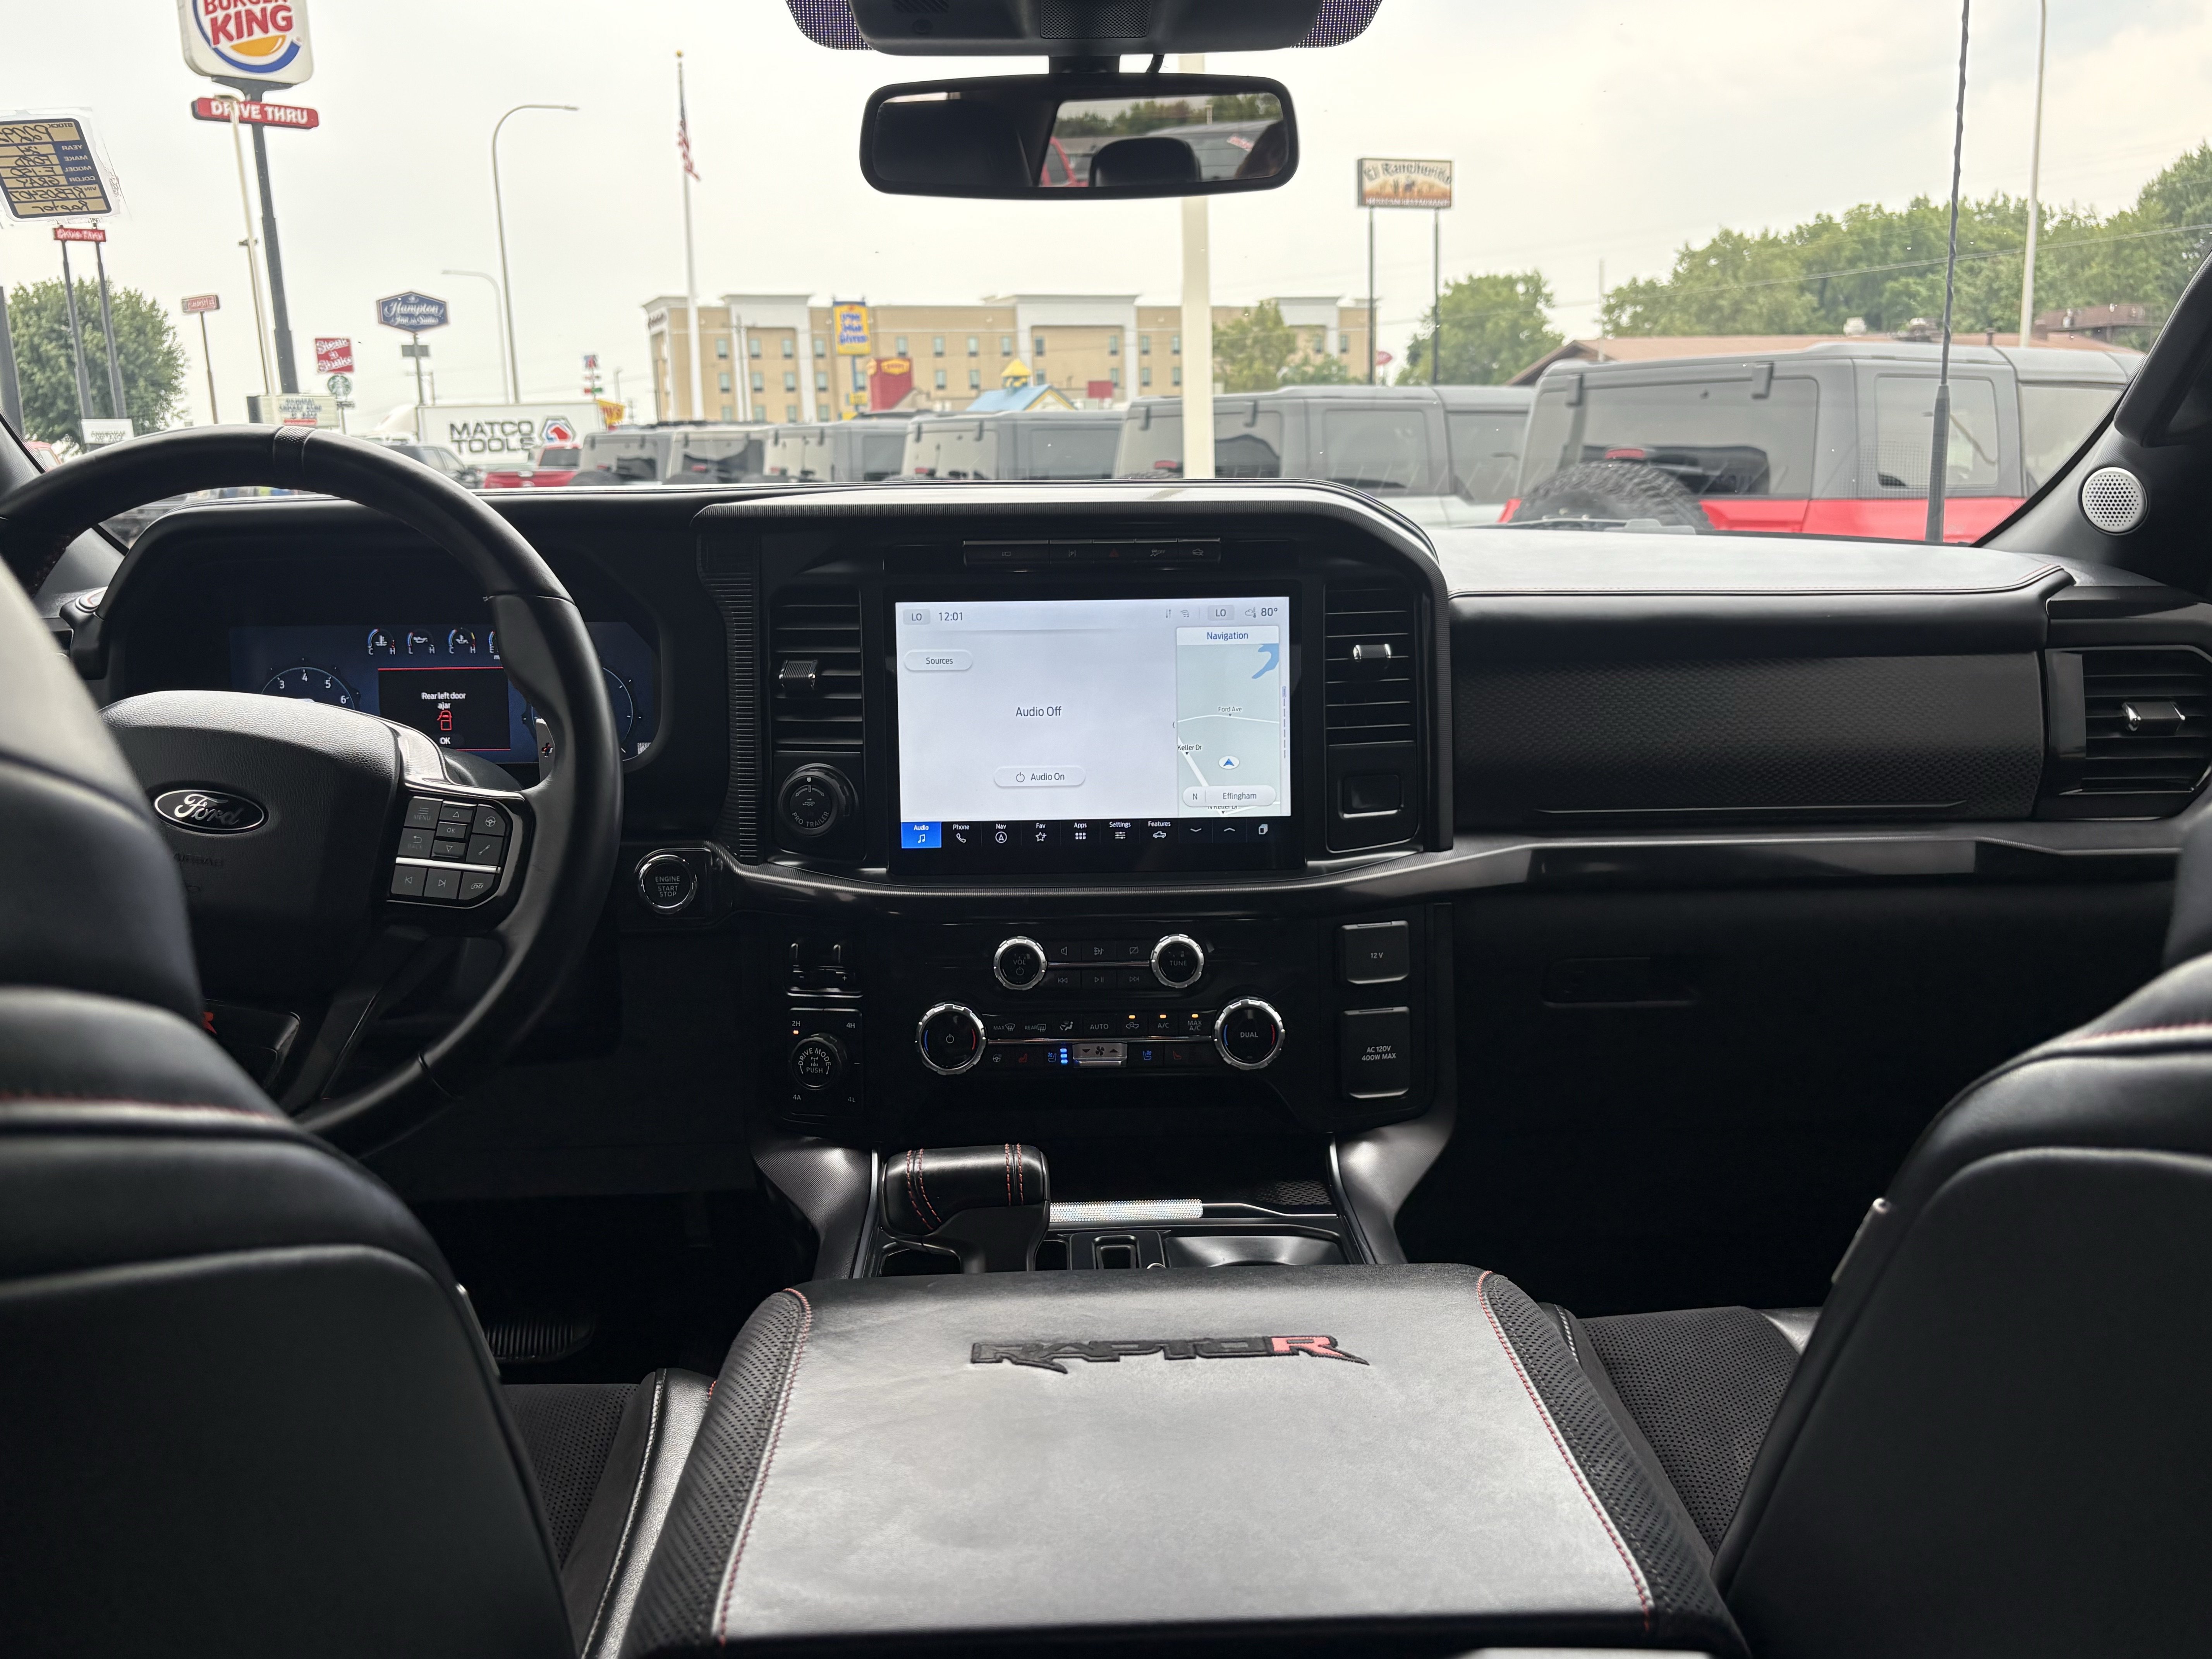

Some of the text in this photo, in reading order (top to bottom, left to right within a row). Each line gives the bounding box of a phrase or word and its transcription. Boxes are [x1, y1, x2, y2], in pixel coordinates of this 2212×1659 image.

[210, 5, 293, 46] KING
[264, 107, 307, 124] THRU
[383, 301, 444, 317] Hampton
[450, 421, 534, 439] MATCO
[938, 612, 964, 622] 12:01
[1216, 608, 1226, 617] LO
[1261, 607, 1278, 617] 80°
[911, 613, 922, 622] LO
[1206, 631, 1249, 641] Navigation
[926, 657, 953, 665] Sources
[302, 673, 308, 682] 4
[279, 680, 285, 689] 3
[325, 680, 331, 689] 5
[340, 696, 347, 704] 6
[1015, 706, 1062, 717] Audio Off
[1030, 772, 1065, 781] Audio On
[1223, 792, 1257, 801] Effingham
[174, 794, 244, 825] Ford
[792, 812, 830, 828] PRO TRAILER
[1109, 821, 1131, 829] Settings
[798, 1048, 831, 1065] DRIVE MODE
[970, 1335, 1369, 1374] RAPTOR
